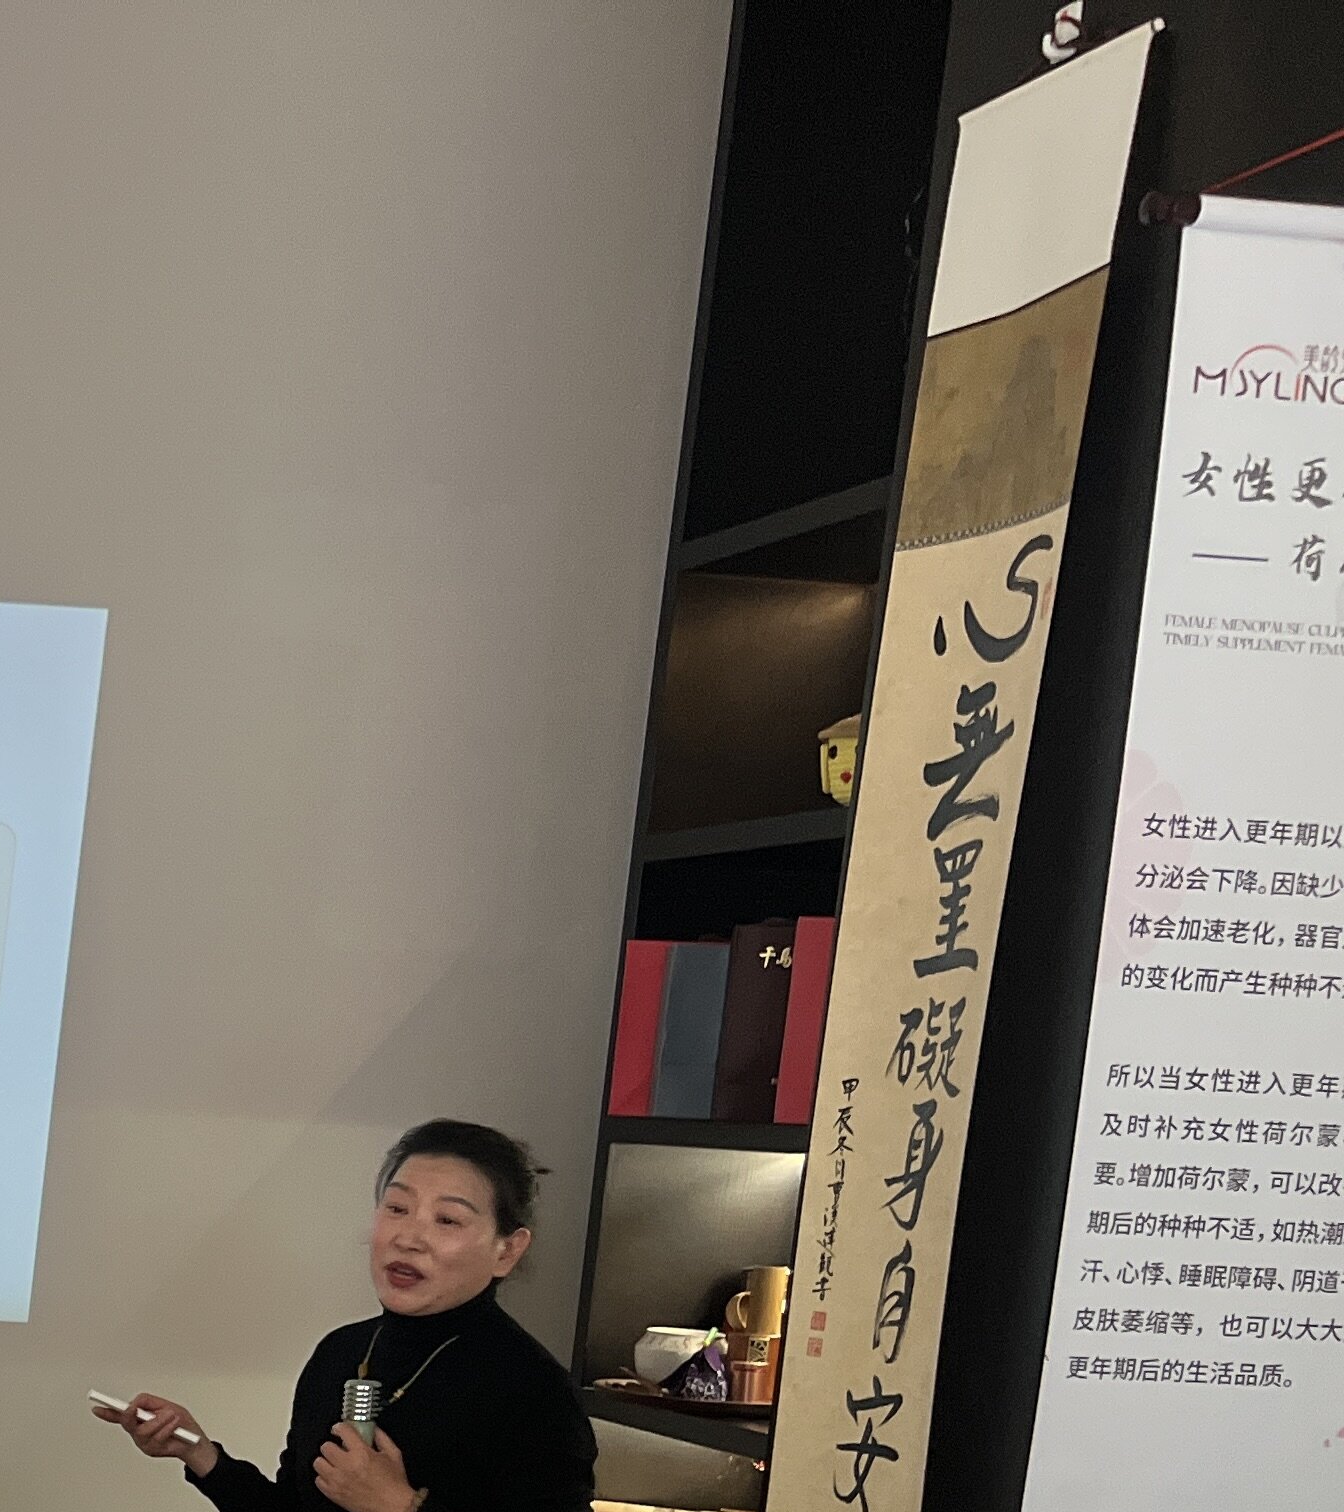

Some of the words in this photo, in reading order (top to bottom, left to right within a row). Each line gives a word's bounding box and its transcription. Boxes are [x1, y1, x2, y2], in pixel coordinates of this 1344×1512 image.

[1182, 451, 1344, 509] 女性更
[1289, 534, 1344, 582] 荷
[1164, 613, 1217, 630] FEMALE
[1221, 617, 1304, 635] MENOPAUSE
[1163, 632, 1213, 648] TIMELY
[1217, 636, 1306, 654] SUPPLEMENT
[1141, 812, 1343, 849] 女性进入更年期以
[1128, 913, 1344, 950] 体会加速老化，器官
[1120, 963, 1344, 1000] 的变化而产生种种不
[1106, 1063, 1344, 1099] 所以当女性进入更年
[1079, 1258, 1344, 1294] 汗、心悸、睡眠障碍、阴道
[1065, 1355, 1294, 1389] 更年期后的生活品质。
